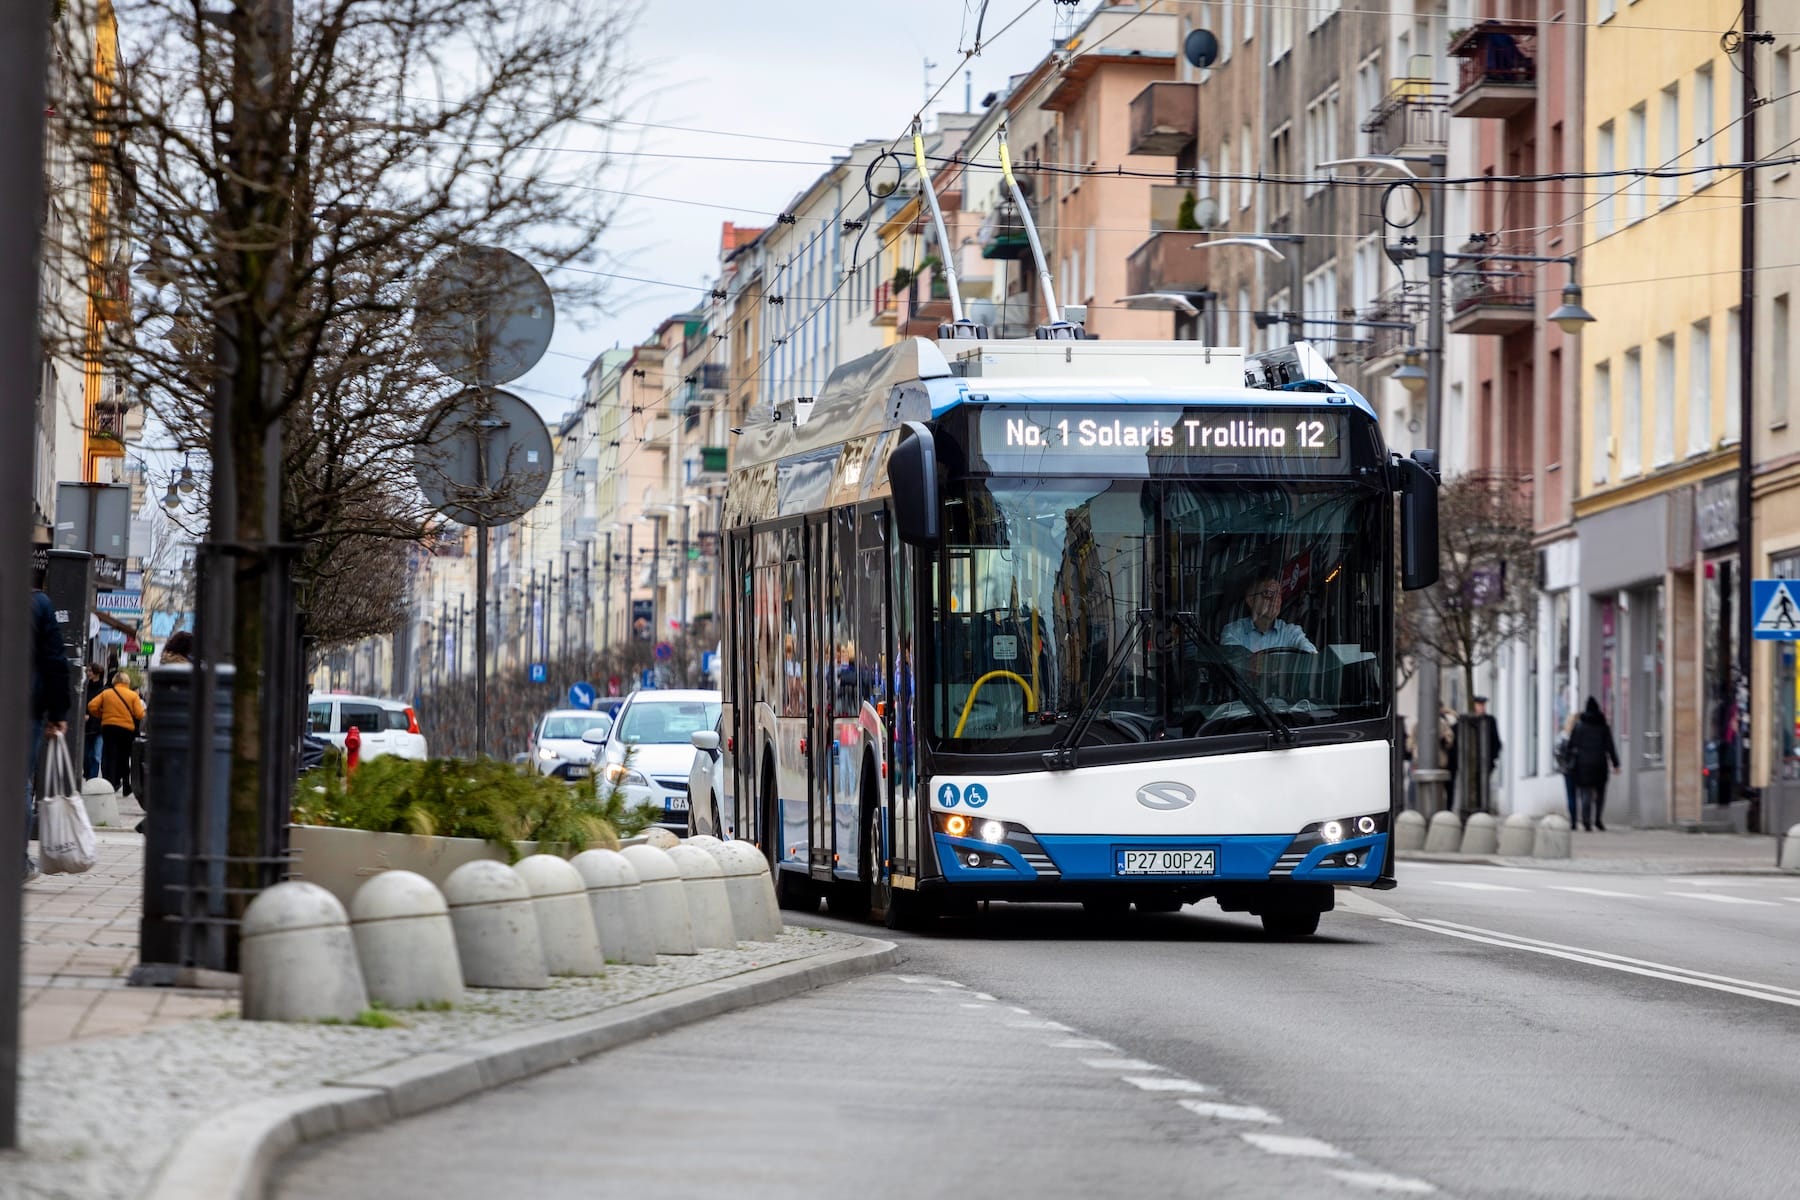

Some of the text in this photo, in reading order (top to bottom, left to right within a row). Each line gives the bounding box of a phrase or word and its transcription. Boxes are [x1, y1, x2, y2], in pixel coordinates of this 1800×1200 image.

[1006, 419, 1325, 447] No. 1 Solaris Trollino 12
[1127, 853, 1157, 869] P27
